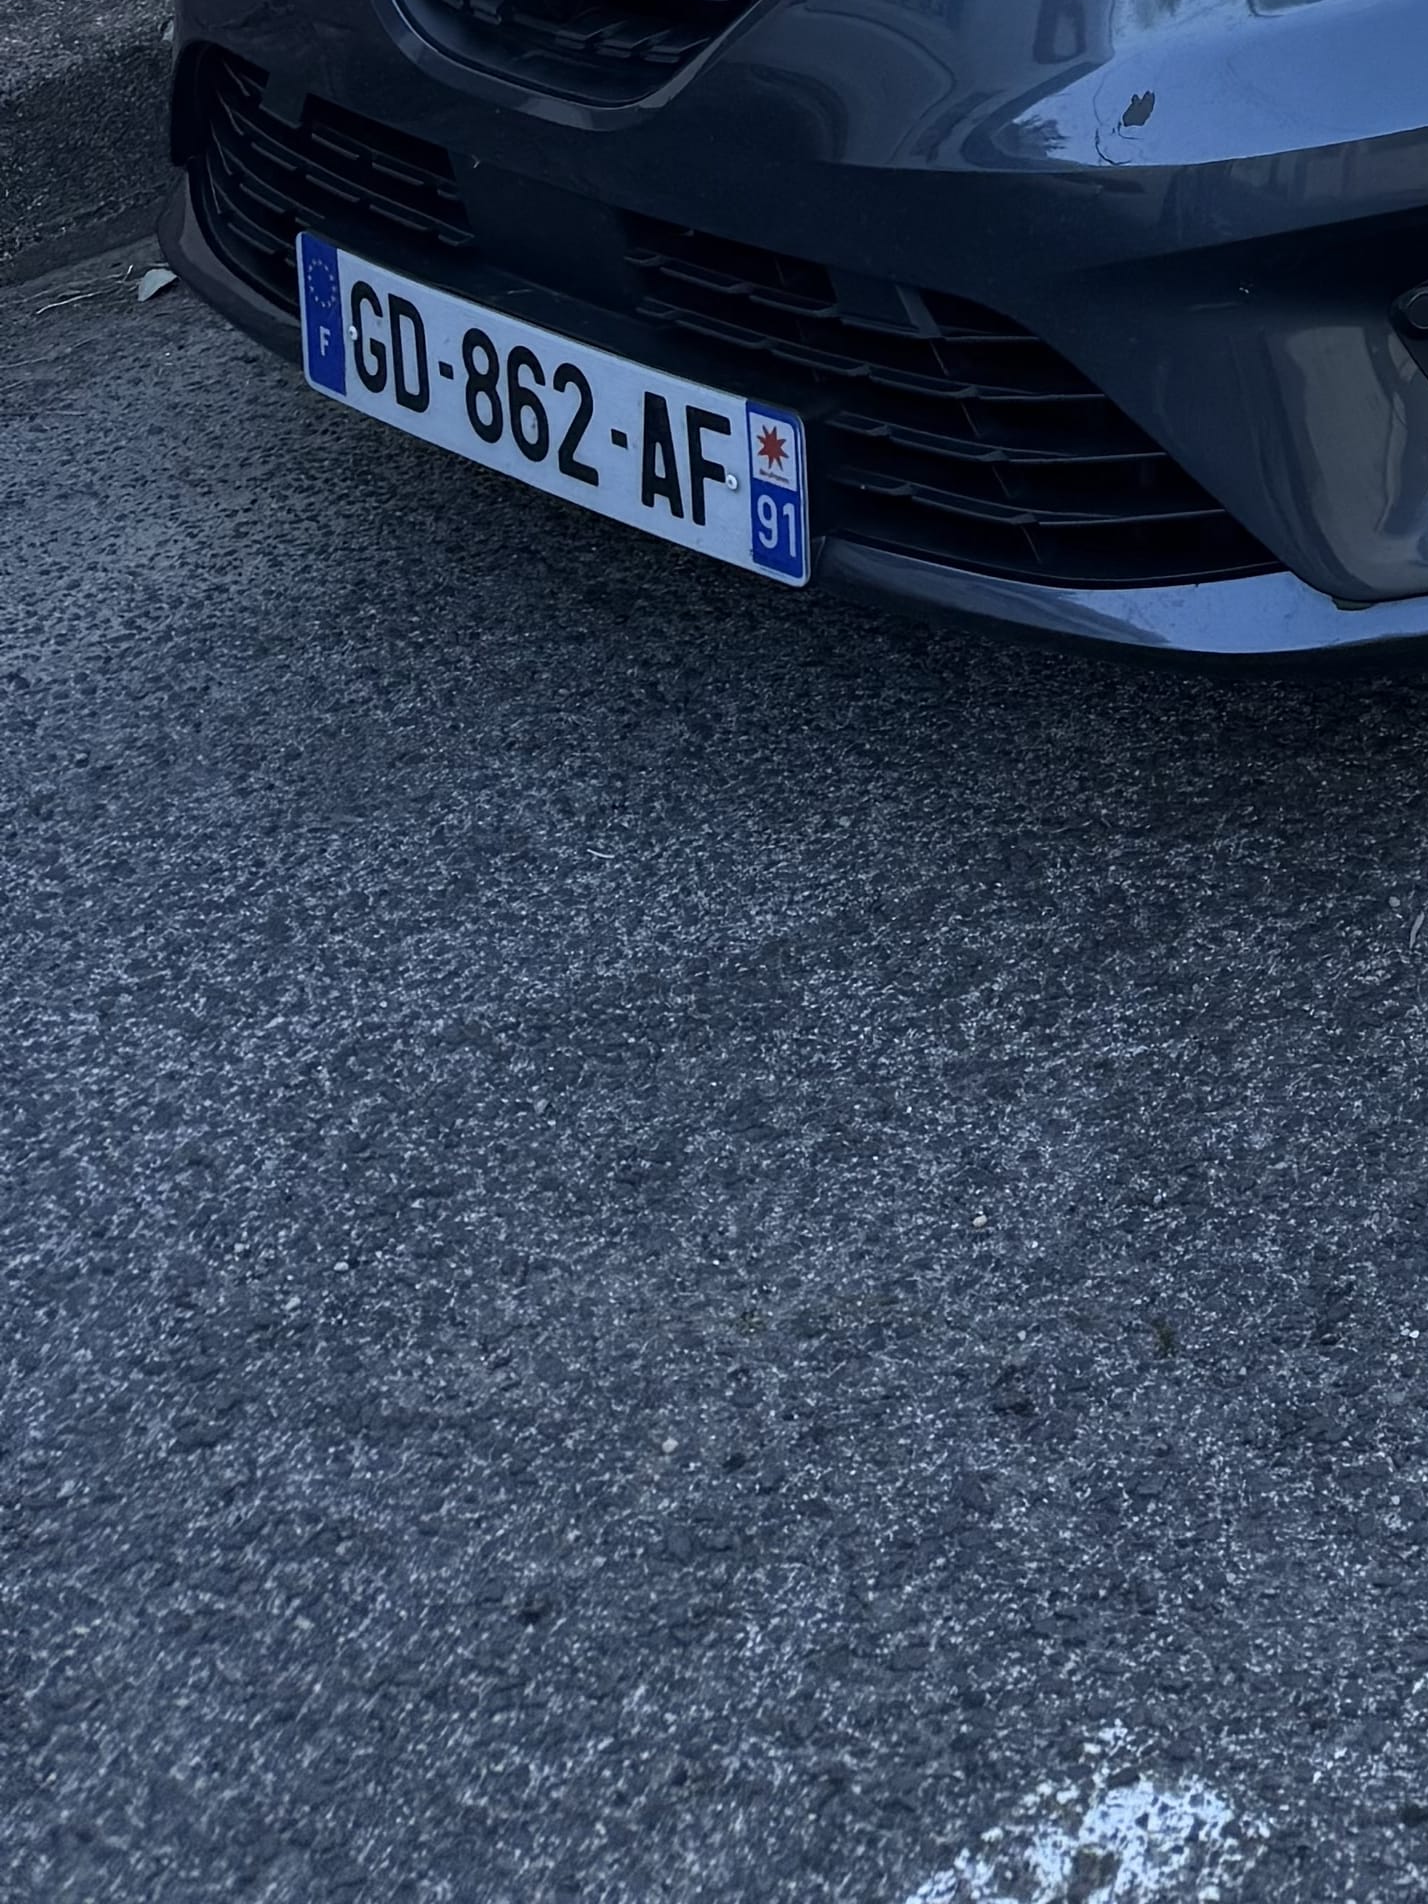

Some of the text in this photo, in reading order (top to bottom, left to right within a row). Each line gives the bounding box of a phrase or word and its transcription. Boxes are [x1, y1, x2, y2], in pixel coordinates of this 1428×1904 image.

[319, 325, 332, 358] F
[350, 279, 732, 527] GD-862-AF
[757, 493, 797, 559] 91
